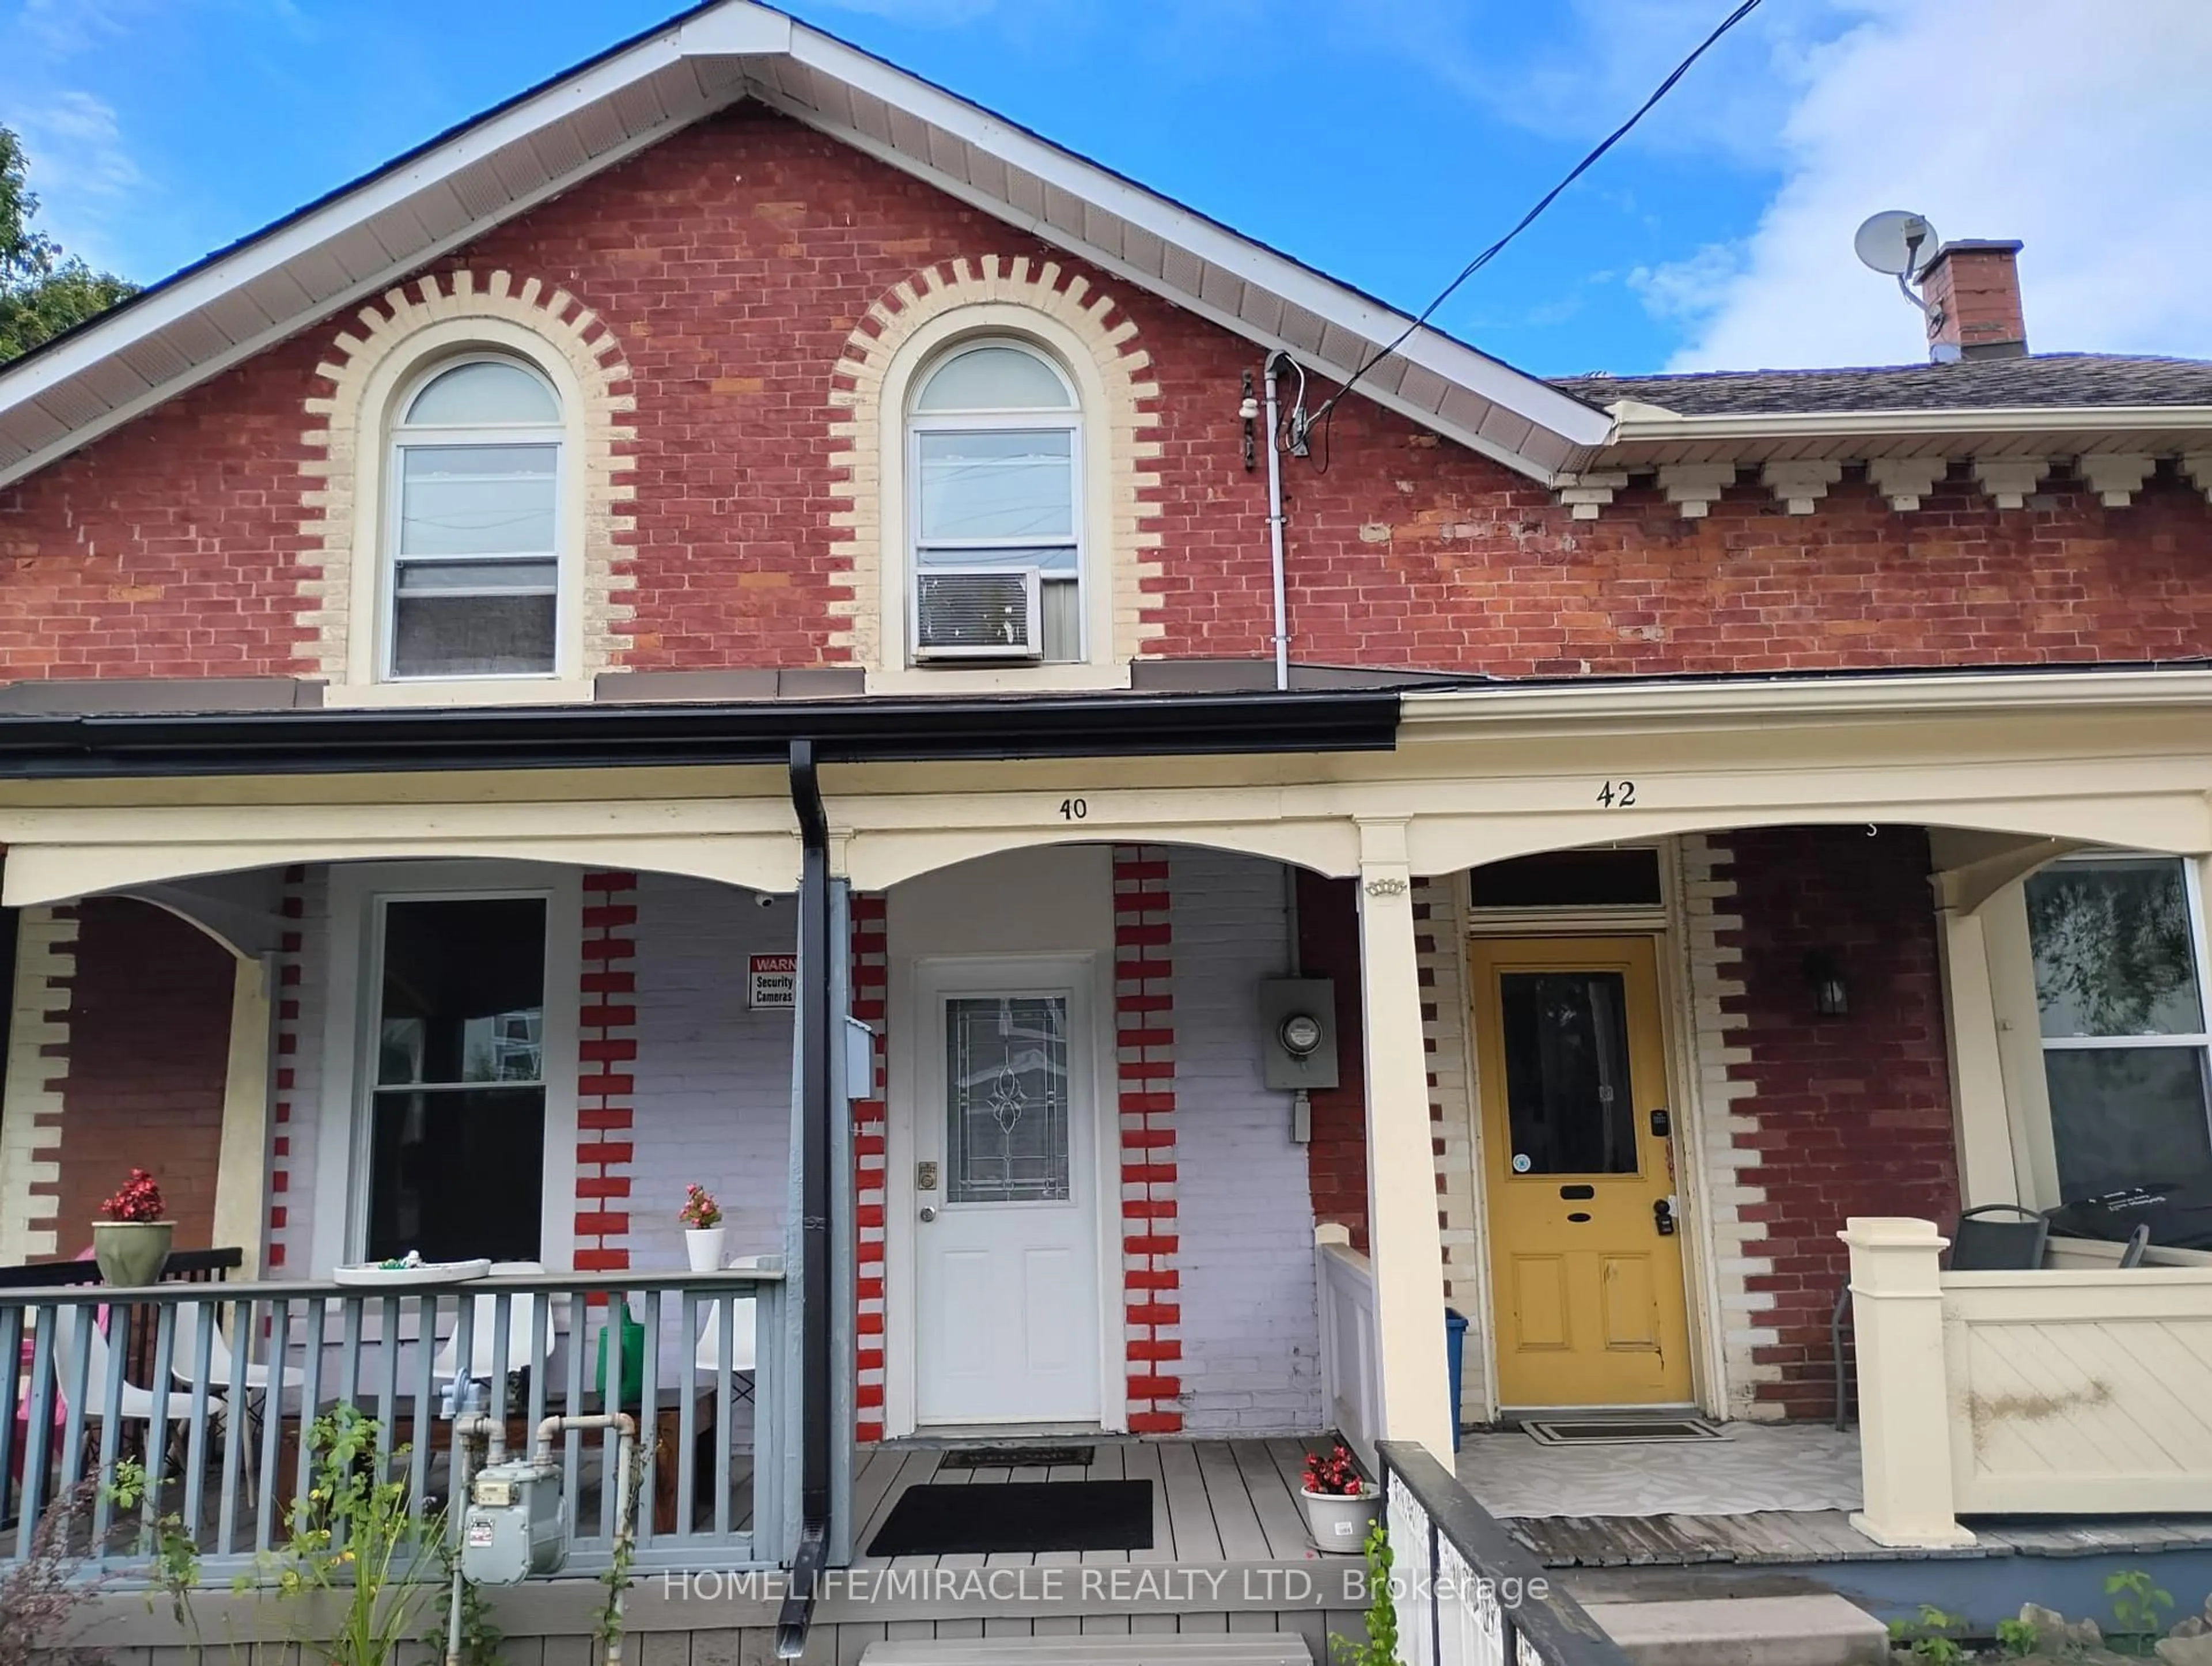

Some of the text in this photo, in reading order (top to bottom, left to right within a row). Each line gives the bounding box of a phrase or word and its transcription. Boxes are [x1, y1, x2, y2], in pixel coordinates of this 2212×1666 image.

[1596, 781, 1635, 808] 42
[1060, 798, 1086, 820] 40
[756, 976, 793, 990] Security
[756, 991, 793, 1002] Cameras
